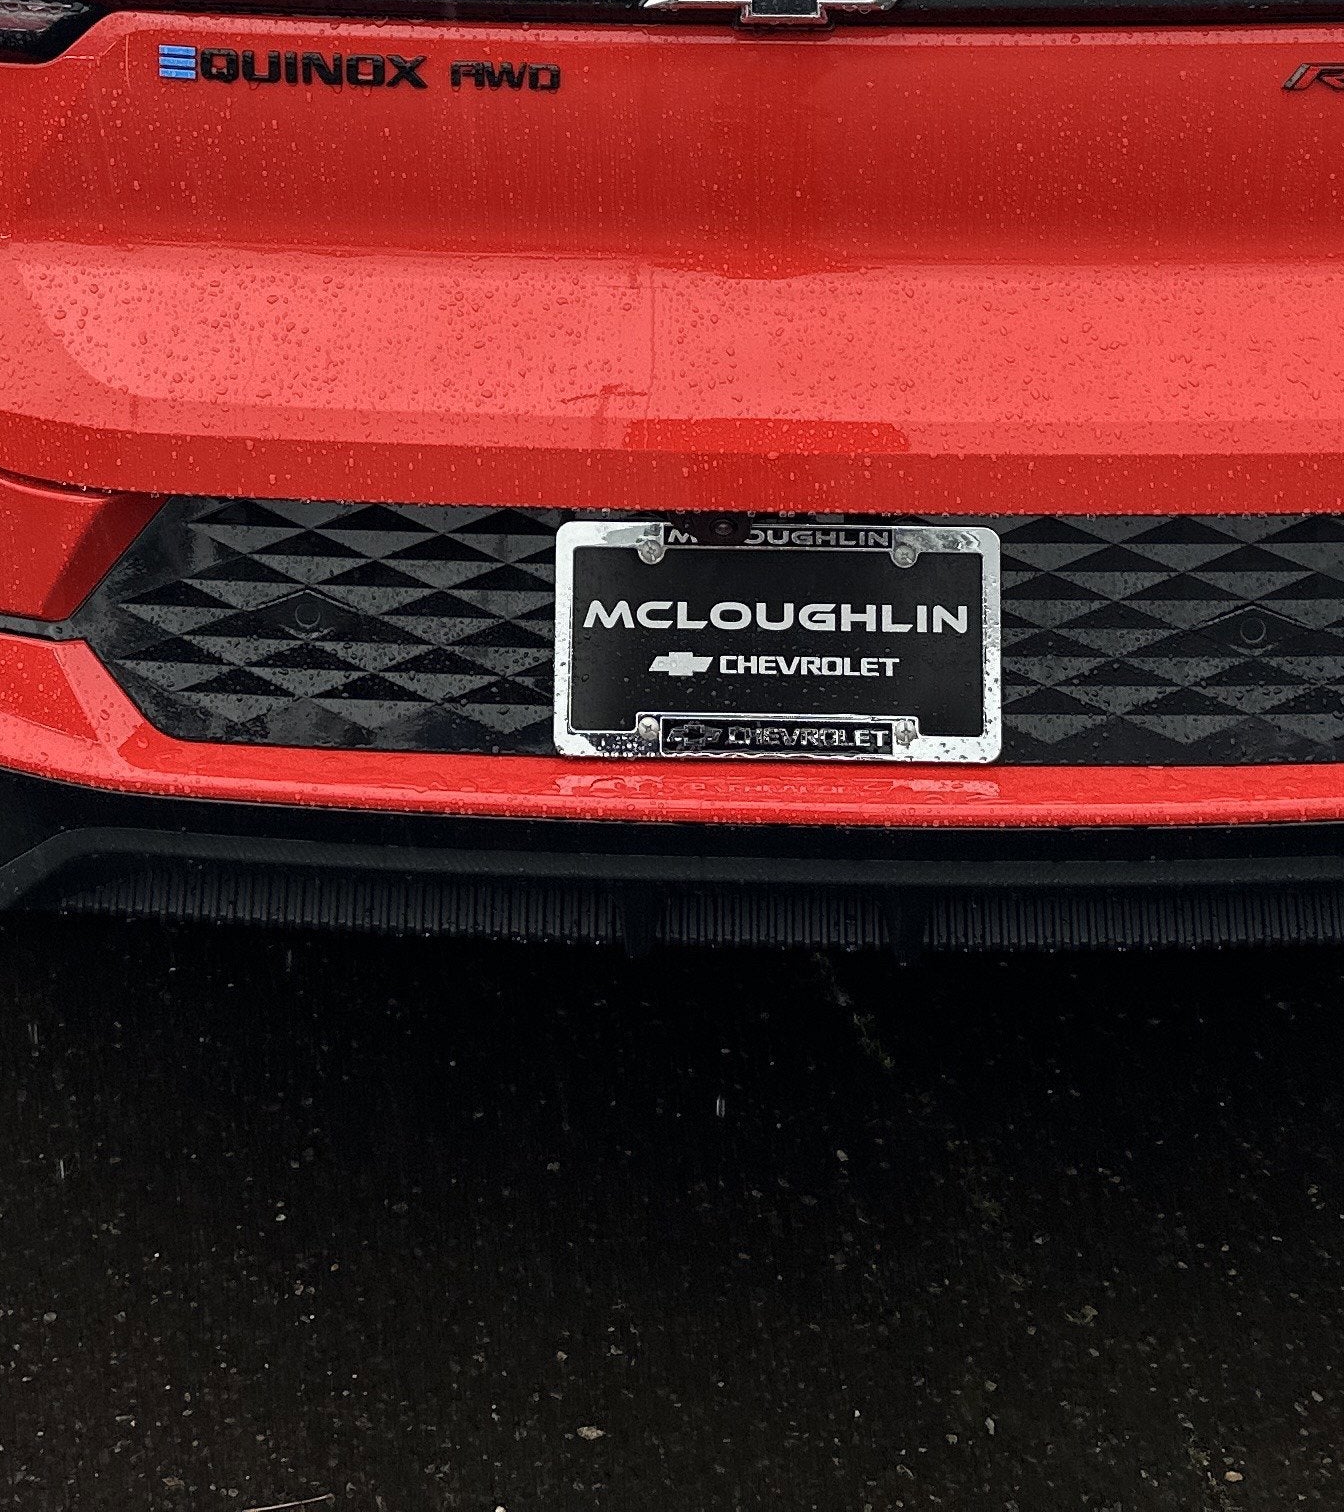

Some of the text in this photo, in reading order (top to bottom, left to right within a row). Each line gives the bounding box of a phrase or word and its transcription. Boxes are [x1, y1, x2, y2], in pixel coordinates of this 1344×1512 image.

[158, 44, 561, 92] EQUINOX AWD
[668, 528, 890, 547] MOUGHLIN
[582, 599, 968, 634] MCLOUGHLIN
[719, 655, 900, 677] CHEVROLET
[728, 727, 890, 748] CHEVROLET
